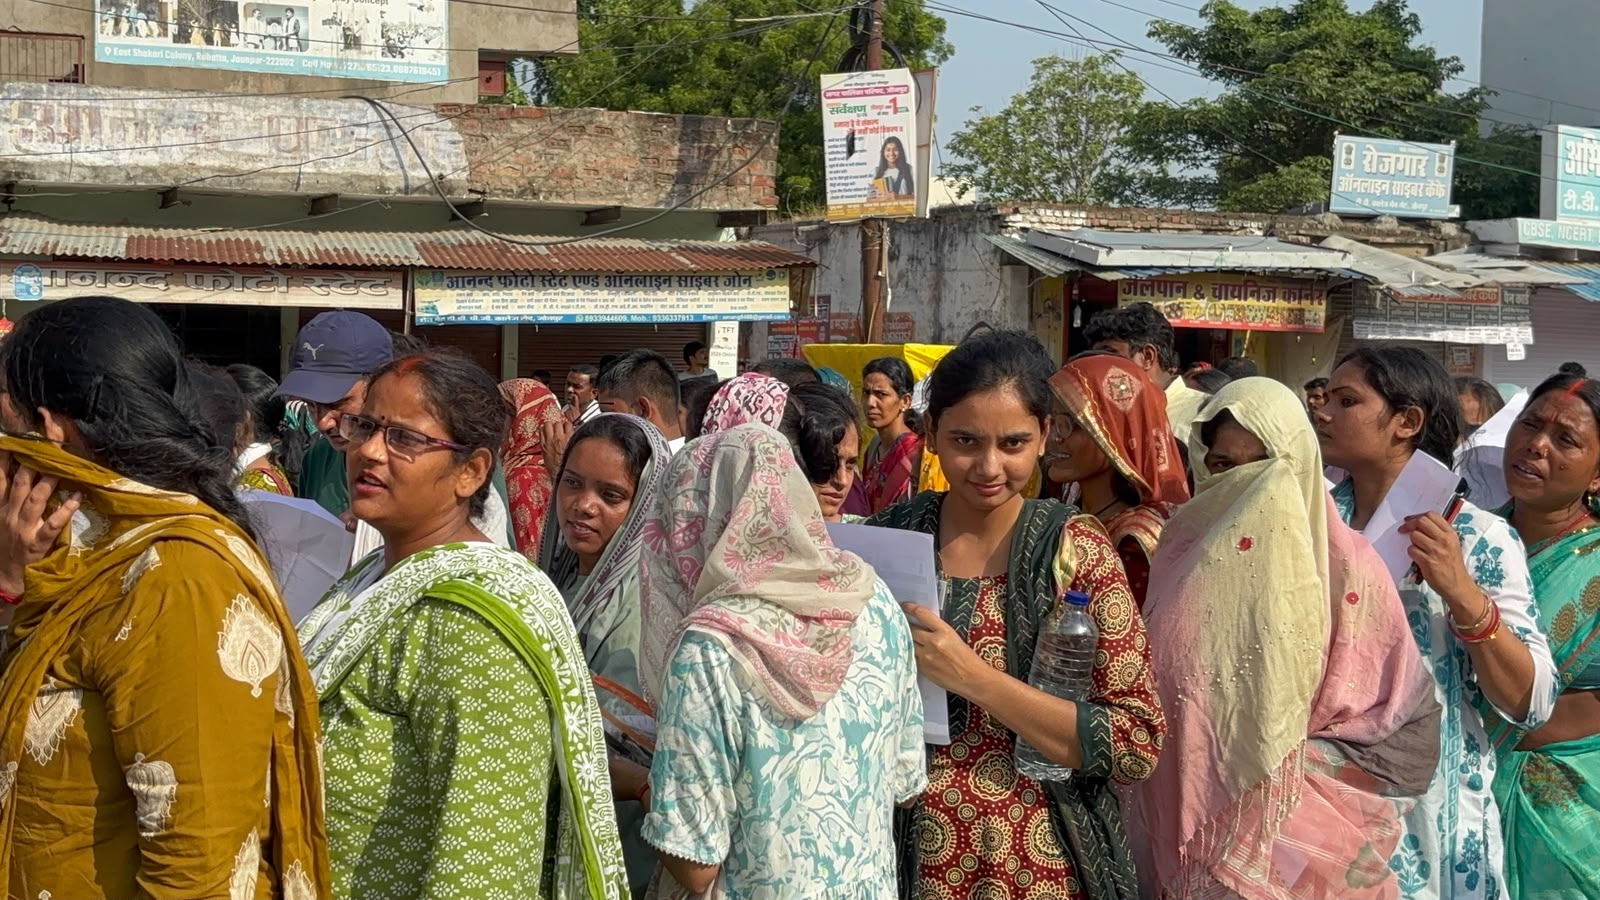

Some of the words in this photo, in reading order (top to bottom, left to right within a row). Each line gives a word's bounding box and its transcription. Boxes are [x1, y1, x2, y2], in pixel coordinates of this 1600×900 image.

[113, 47, 132, 57] East
[1362, 144, 1429, 178] रोजगार
[1338, 173, 1390, 197] ऑनलाइन
[1391, 180, 1425, 199] साइबर
[1523, 222, 1555, 240] CBSE,
[1558, 226, 1595, 243] NCERT,
[183, 268, 293, 293] फोटो
[302, 271, 392, 297] स्टेट
[446, 274, 494, 290] आनन्द
[497, 271, 536, 289] फोटो
[539, 271, 569, 289] स्टेट
[572, 274, 599, 290] एण्ड
[604, 270, 673, 290] ऑनलाइन
[723, 271, 753, 288] जोन
[1122, 278, 1188, 299] जलपान
[1193, 284, 1206, 300] &
